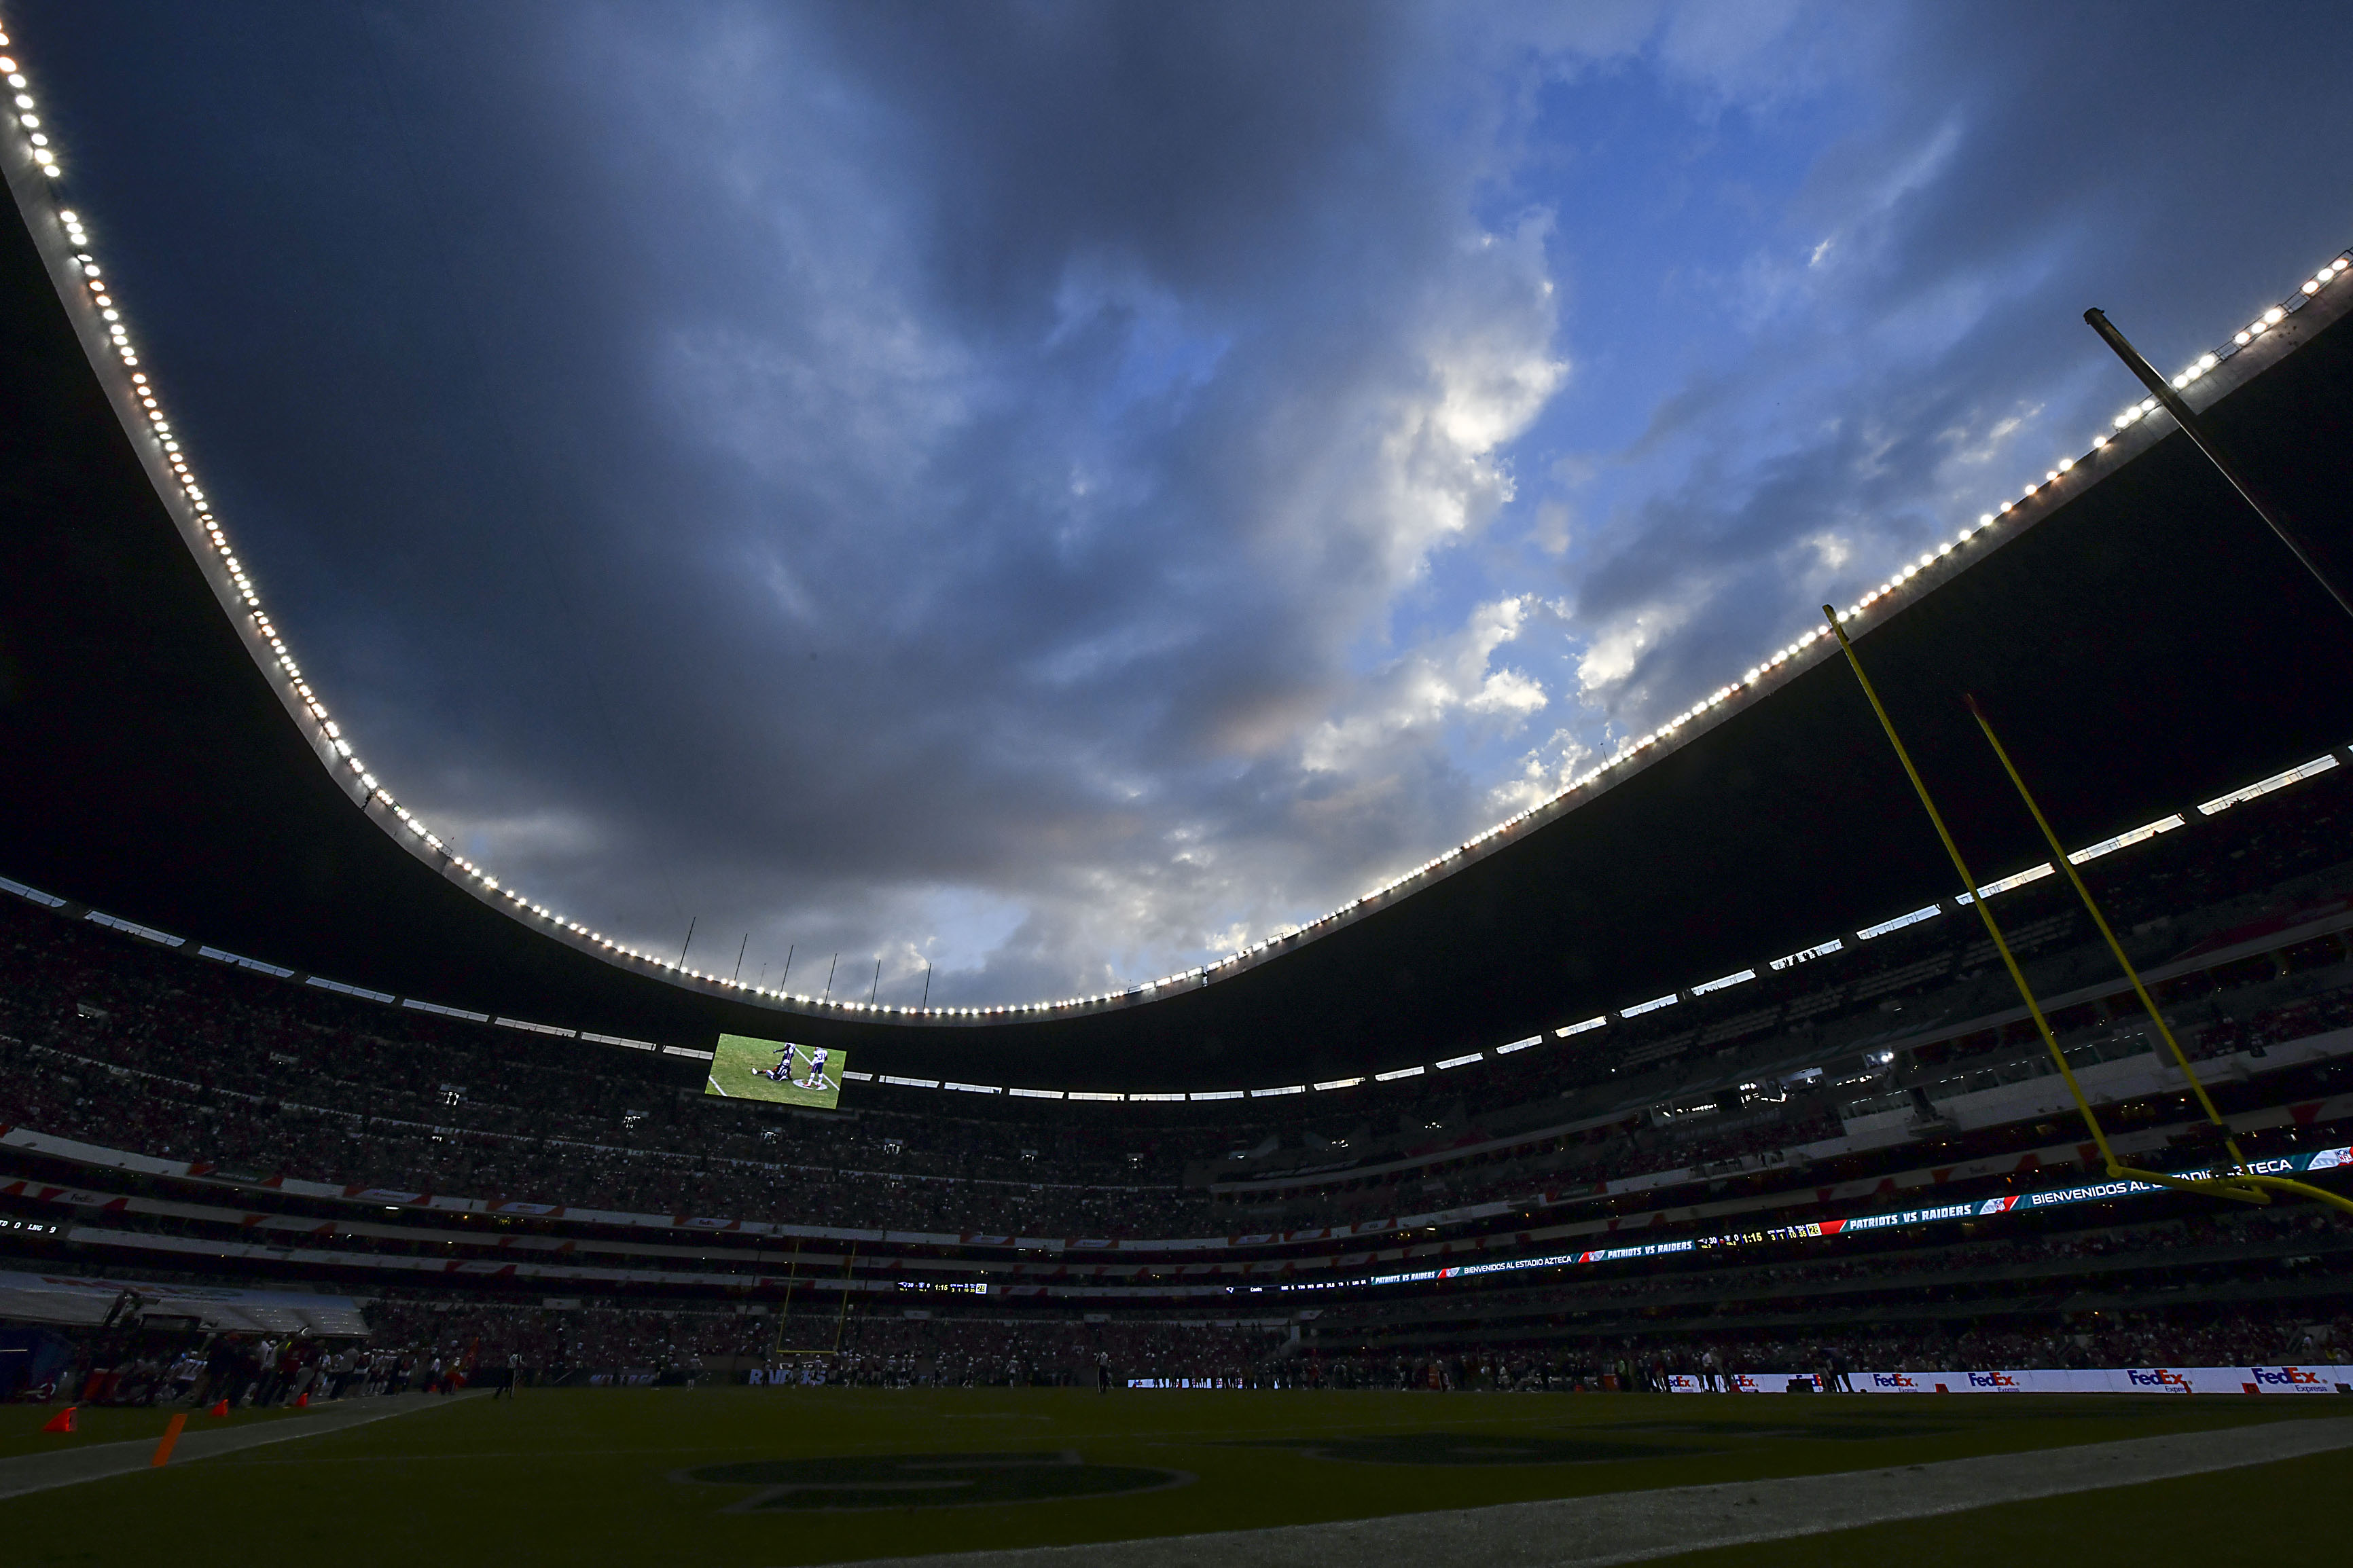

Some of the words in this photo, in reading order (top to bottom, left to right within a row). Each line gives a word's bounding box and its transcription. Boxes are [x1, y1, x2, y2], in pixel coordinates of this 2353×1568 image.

[777, 1067, 788, 1076] 10
[2032, 1182, 2127, 1205] BIENVENIDOS
[2130, 1181, 2150, 1192] AL
[1850, 1214, 1898, 1230] PATRIOTS
[1903, 1211, 1917, 1223] VS
[1922, 1204, 1971, 1220] RAIDERS
[1742, 1232, 1763, 1243] 1:15
[1809, 1226, 1819, 1235] 28
[1607, 1247, 1642, 1259] PATRIOTS
[1645, 1245, 1655, 1254] VS
[1657, 1241, 1692, 1253] RAIDERS
[1464, 1262, 1505, 1274] BIENVENIDOS
[1515, 1258, 1543, 1269] ESTADIO
[1544, 1255, 1572, 1264] AZTECA
[1375, 1275, 1401, 1284] PATRIOTS
[1411, 1271, 1435, 1280] RAIDERS
[1668, 1376, 1691, 1387] edEx
[1873, 1373, 1915, 1387] FedEx
[1968, 1372, 2017, 1386] FedEx
[2127, 1369, 2184, 1385] FedEx
[2250, 1366, 2320, 1384] FedEx
[2295, 1385, 2328, 1393] Express
